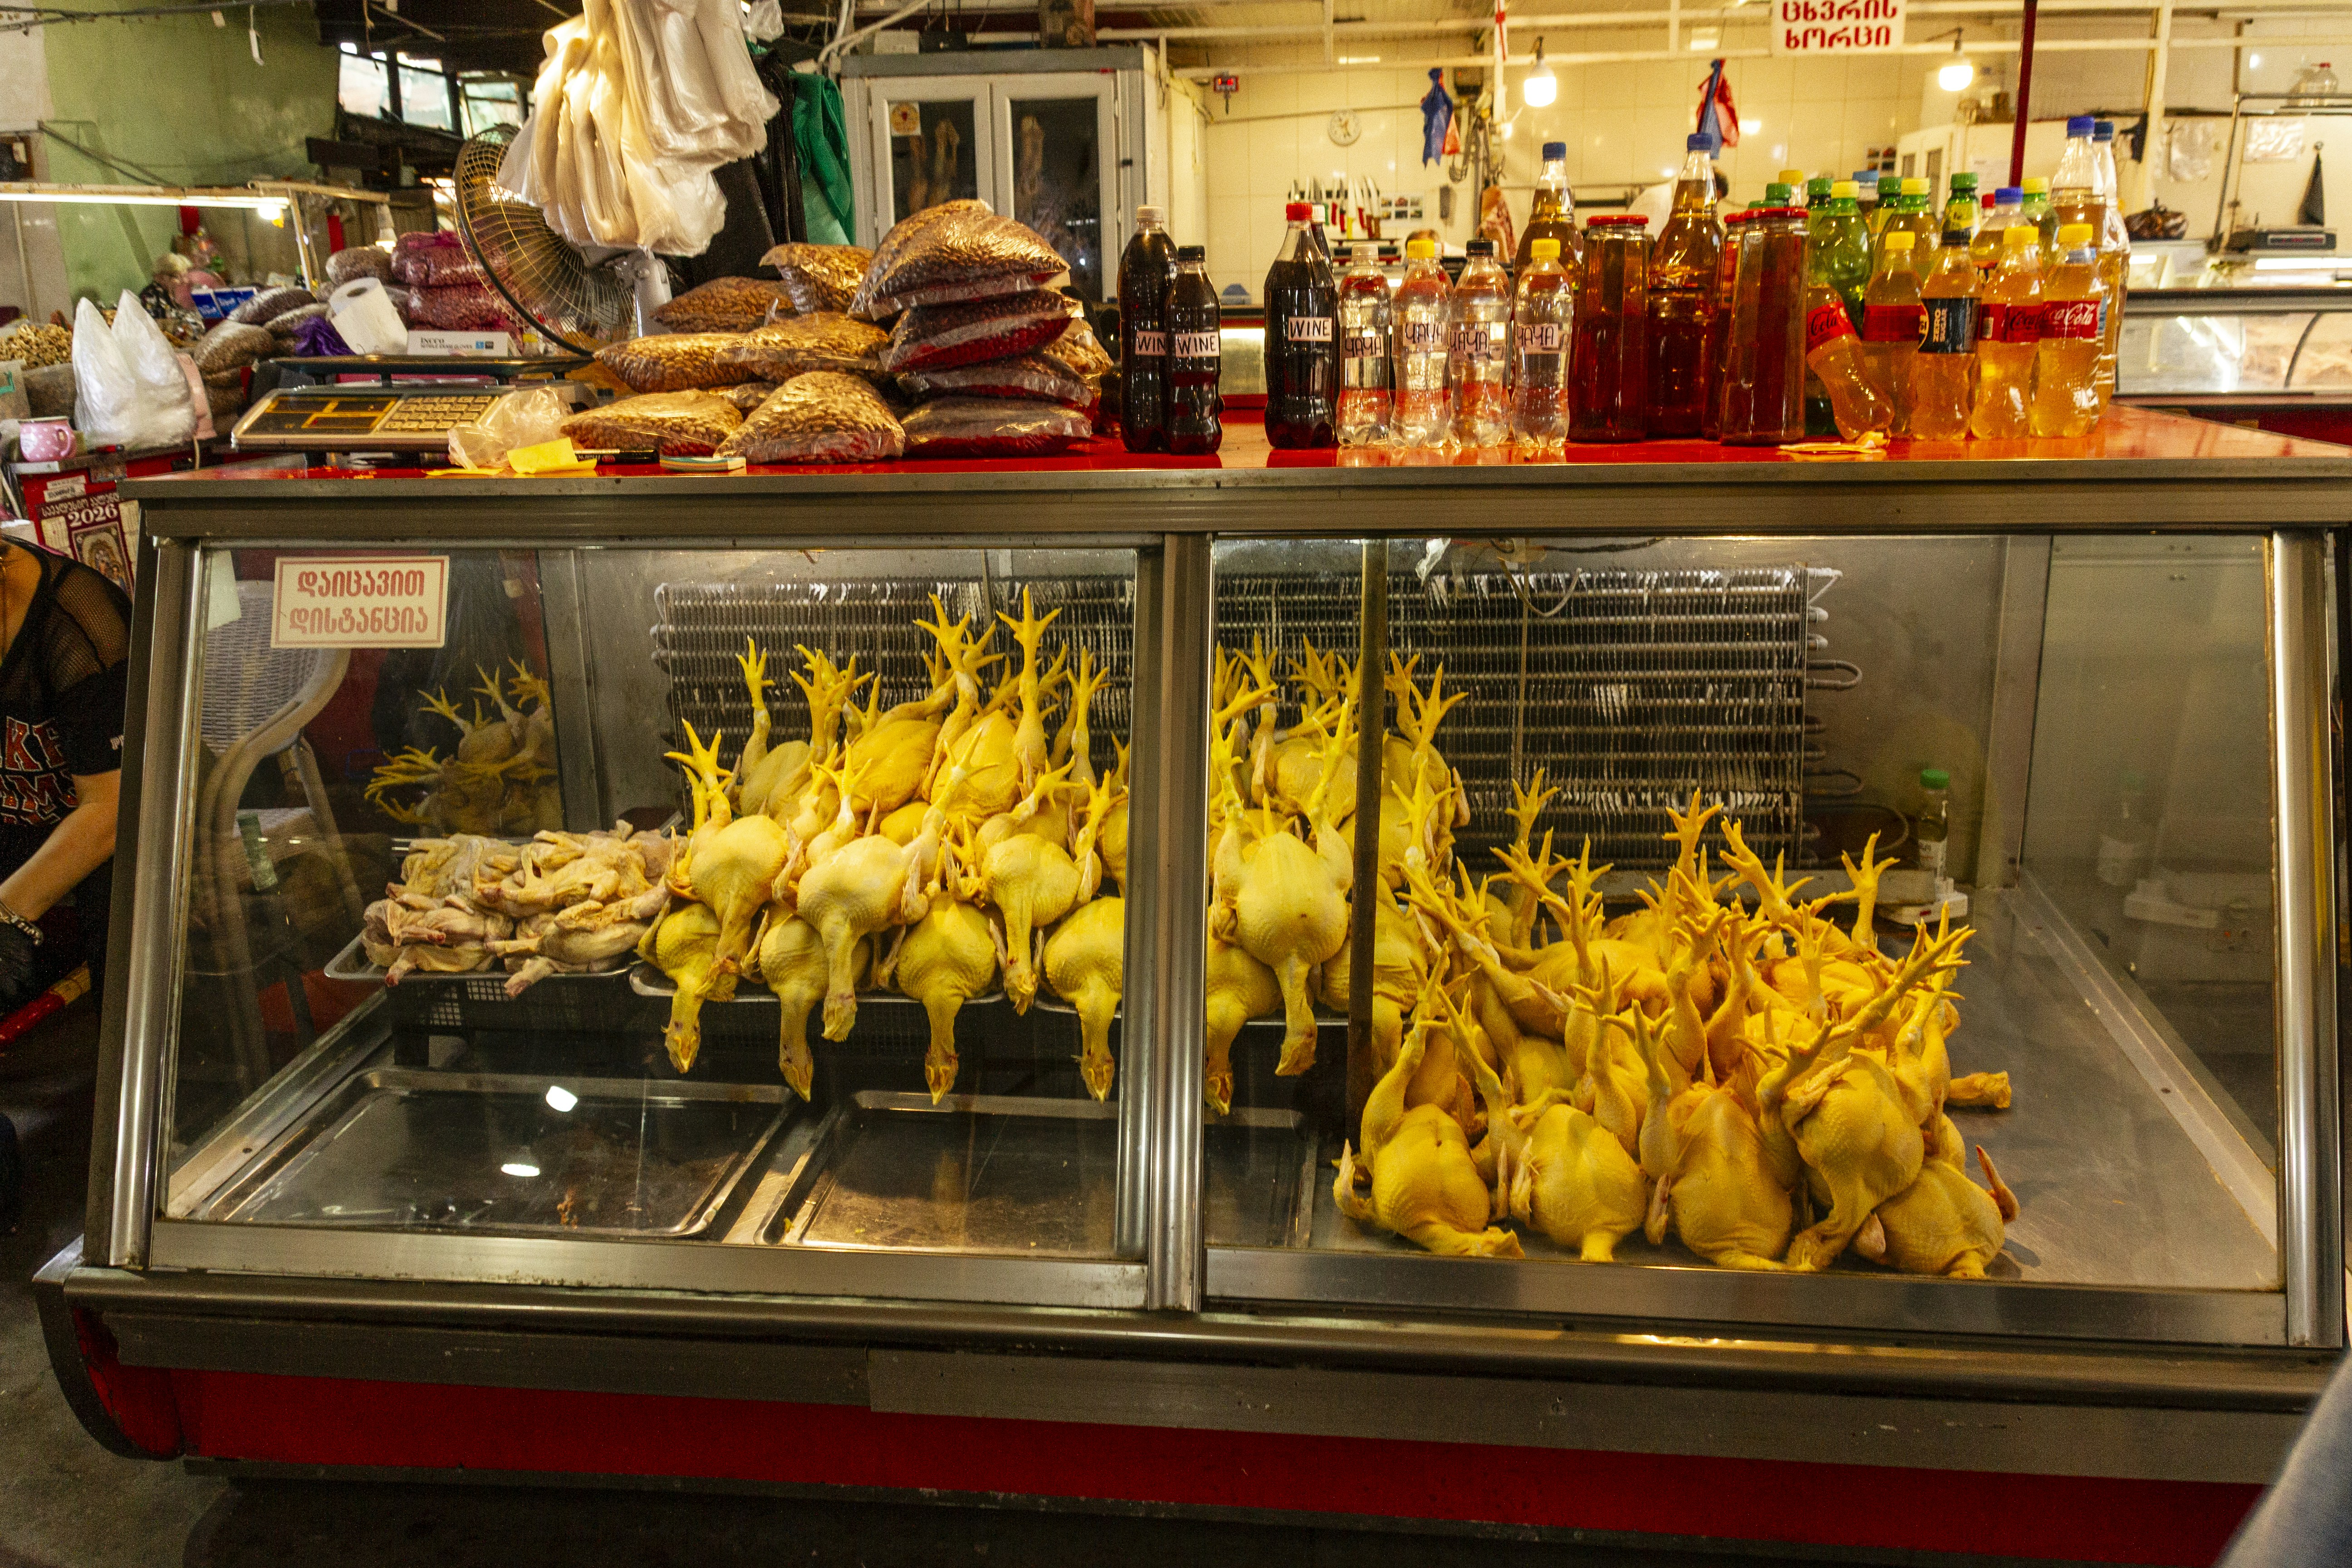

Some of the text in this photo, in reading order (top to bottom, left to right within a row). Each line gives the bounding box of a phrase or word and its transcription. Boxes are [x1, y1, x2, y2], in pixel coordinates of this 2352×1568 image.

[1782, 0, 1897, 22] ცხვრის
[1785, 25, 1891, 49] ხორცი
[1290, 319, 1330, 338] WINE
[1405, 322, 1443, 343] ЧАЧА
[1517, 325, 1554, 347] ЧАЧА
[1933, 308, 1941, 343] ZERO
[1137, 336, 1166, 353] WIN
[1177, 335, 1216, 355] WINE
[1345, 334, 1382, 357] ЧАЧА
[1450, 331, 1488, 352] ЧАЧА
[68, 503, 118, 528] 2026
[298, 569, 425, 598] დაიცავით
[289, 606, 428, 635] დისტანცია
